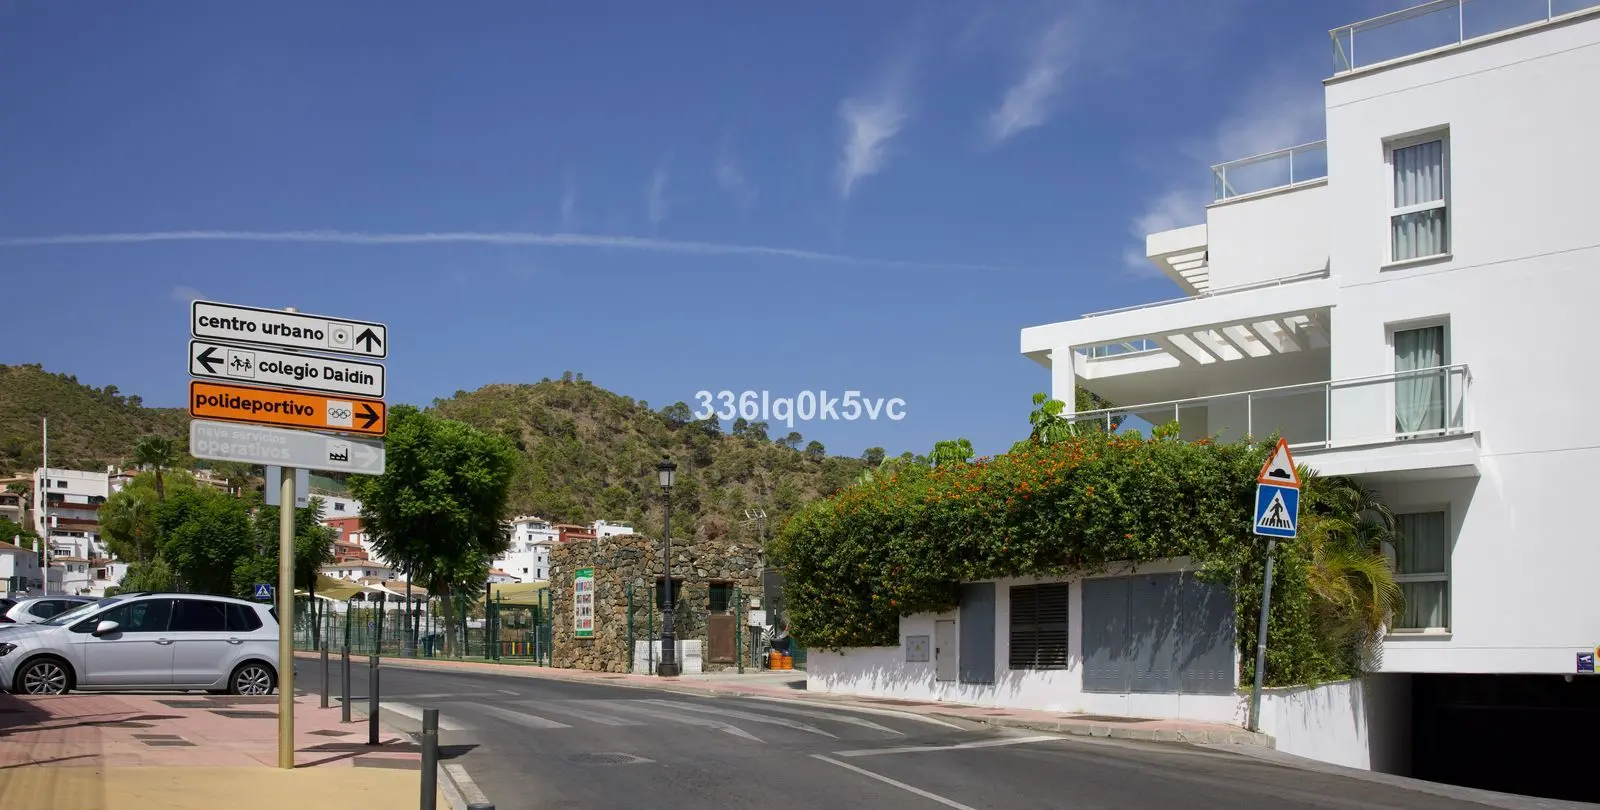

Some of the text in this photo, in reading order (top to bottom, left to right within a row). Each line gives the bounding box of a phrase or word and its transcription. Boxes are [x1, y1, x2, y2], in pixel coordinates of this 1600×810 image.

[198, 315, 324, 341] centro urbano
[258, 360, 374, 385] colegio Daidín
[195, 393, 315, 417] polideportivo
[197, 439, 291, 459] operativos
[231, 430, 286, 445] servicios
